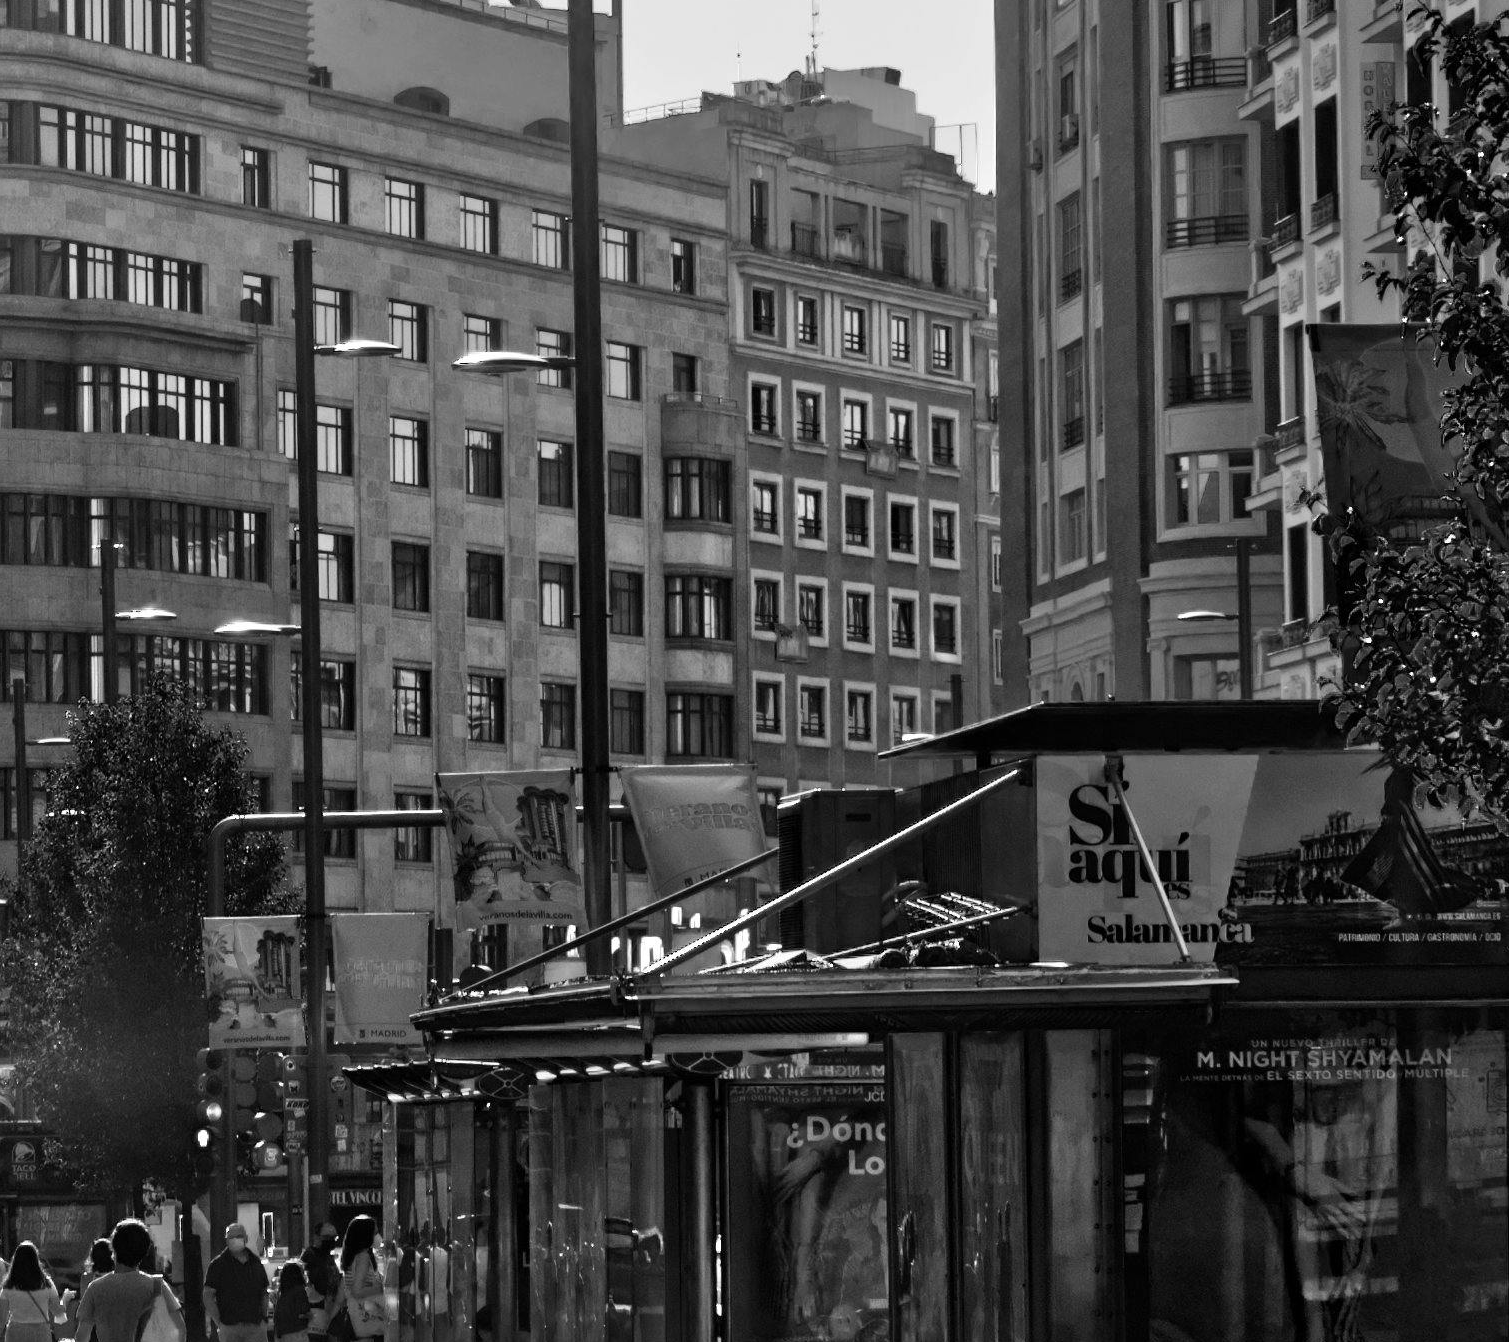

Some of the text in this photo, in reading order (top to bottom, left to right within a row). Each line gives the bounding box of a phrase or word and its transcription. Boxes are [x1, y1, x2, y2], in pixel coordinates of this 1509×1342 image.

[1068, 831, 1193, 899] aquí
[1388, 933, 1419, 942] CULTURA
[1485, 932, 1502, 942] OCIO
[370, 1029, 407, 1039] MADRID
[1197, 1048, 1453, 1068] M. NIGHT SHYAMALAN
[1267, 1070, 1283, 1081] EL
[1287, 1070, 1332, 1081] SEXTO
[1336, 1069, 1396, 1080] SENTIDO
